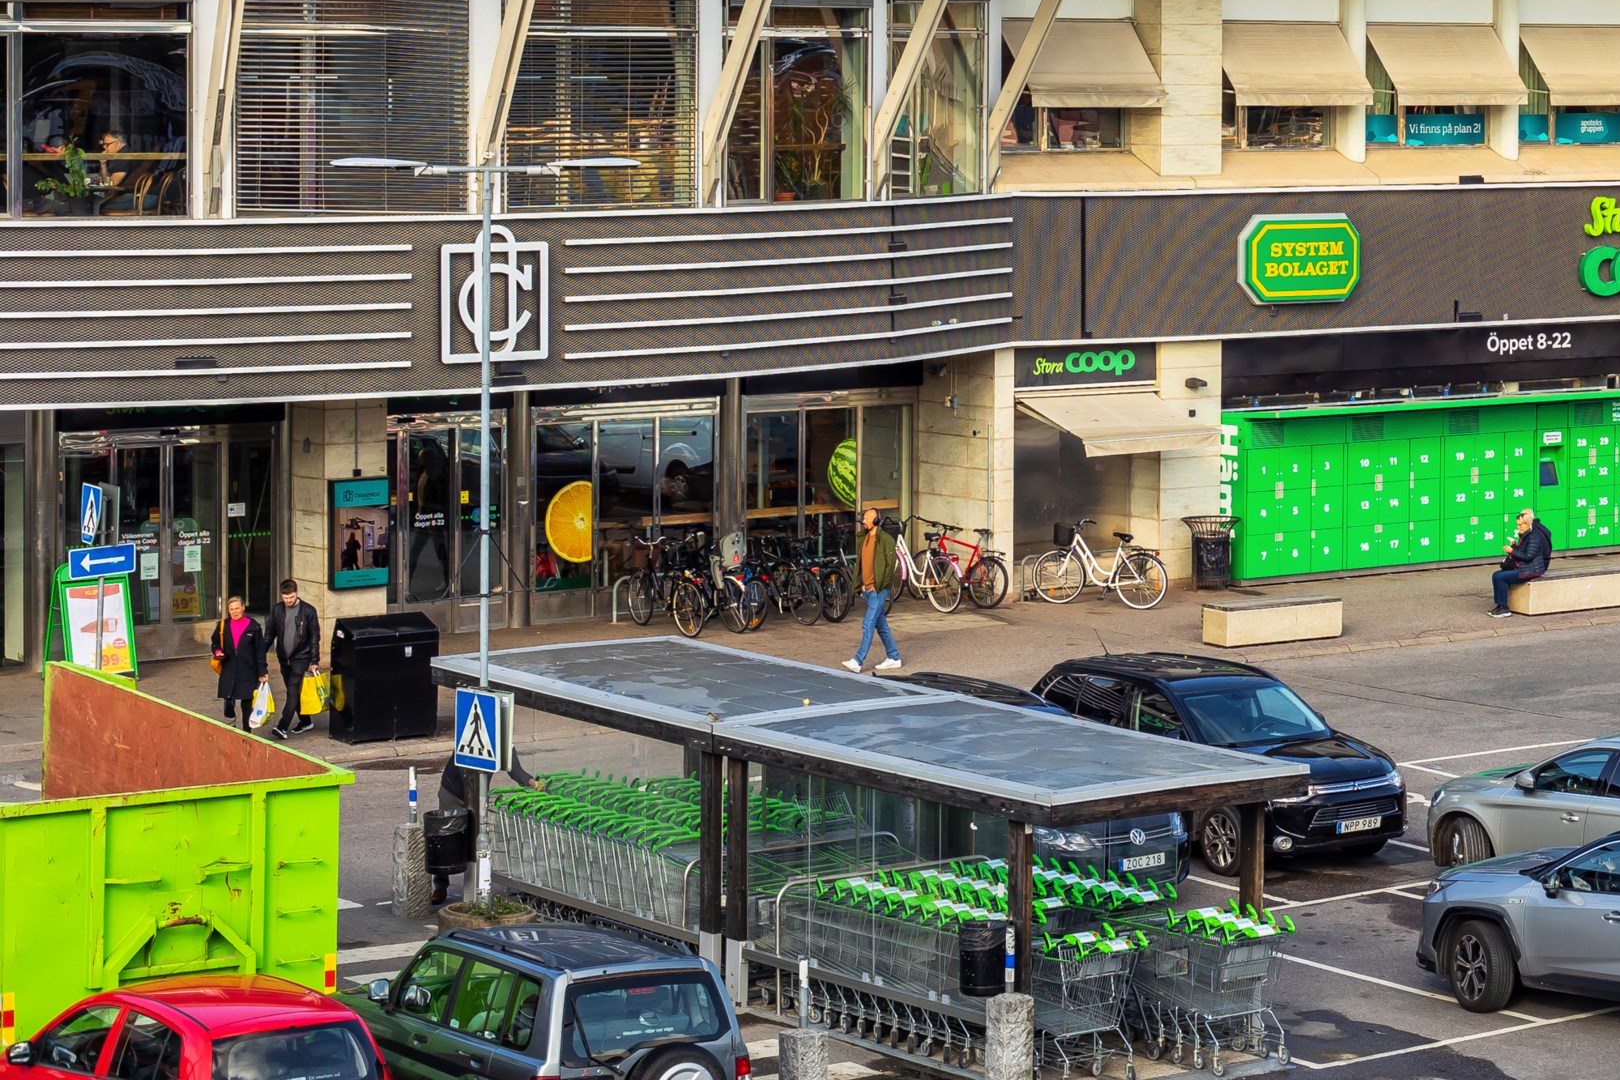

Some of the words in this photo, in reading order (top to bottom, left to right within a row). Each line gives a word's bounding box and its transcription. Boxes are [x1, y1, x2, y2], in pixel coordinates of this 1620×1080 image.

[1409, 124, 1418, 134] Vi
[1420, 123, 1441, 134] finns
[1442, 123, 1453, 136] på
[1454, 123, 1472, 135] plan
[1473, 123, 1481, 133] 2!
[1270, 241, 1344, 258] SYSTEM
[1264, 260, 1349, 278] BOLAGET
[1487, 332, 1534, 355] Öppet
[1537, 332, 1572, 350] 8-22
[1033, 358, 1064, 376] Stora
[1065, 349, 1136, 376] coop
[1576, 438, 1587, 448] 28
[1599, 436, 1610, 446] 29
[1455, 451, 1465, 461] 19
[1484, 449, 1495, 459] 20
[1514, 447, 1523, 457] 21
[1359, 458, 1370, 468] 10
[1389, 456, 1398, 466] 11
[1419, 454, 1429, 464] 12
[1260, 465, 1268, 476] 1
[1292, 463, 1299, 473] 2
[1324, 461, 1331, 471] 3
[1598, 466, 1609, 476] 32
[1577, 468, 1586, 478] 31
[1455, 492, 1466, 503] 22
[1513, 488, 1525, 498] 24
[1388, 498, 1400, 508] 14
[1576, 498, 1587, 508] 34
[1598, 496, 1609, 506] 35
[1260, 508, 1267, 518] 4
[1292, 506, 1299, 516] 5
[1323, 503, 1330, 513] 6
[179, 531, 198, 539] Öppet
[1483, 531, 1495, 541] 26
[1576, 528, 1587, 538] 37
[178, 538, 196, 546] dagar
[1420, 536, 1430, 546] 18
[1455, 533, 1466, 544] 25
[1359, 542, 1370, 552] 16
[1389, 539, 1400, 549] 17
[1260, 551, 1268, 561] 7
[1291, 548, 1299, 558] 8
[1322, 546, 1330, 556] 9
[1345, 821, 1360, 831] NPP
[1362, 819, 1378, 828] 989
[1127, 857, 1143, 869] ZOC
[1146, 854, 1162, 866] 218
